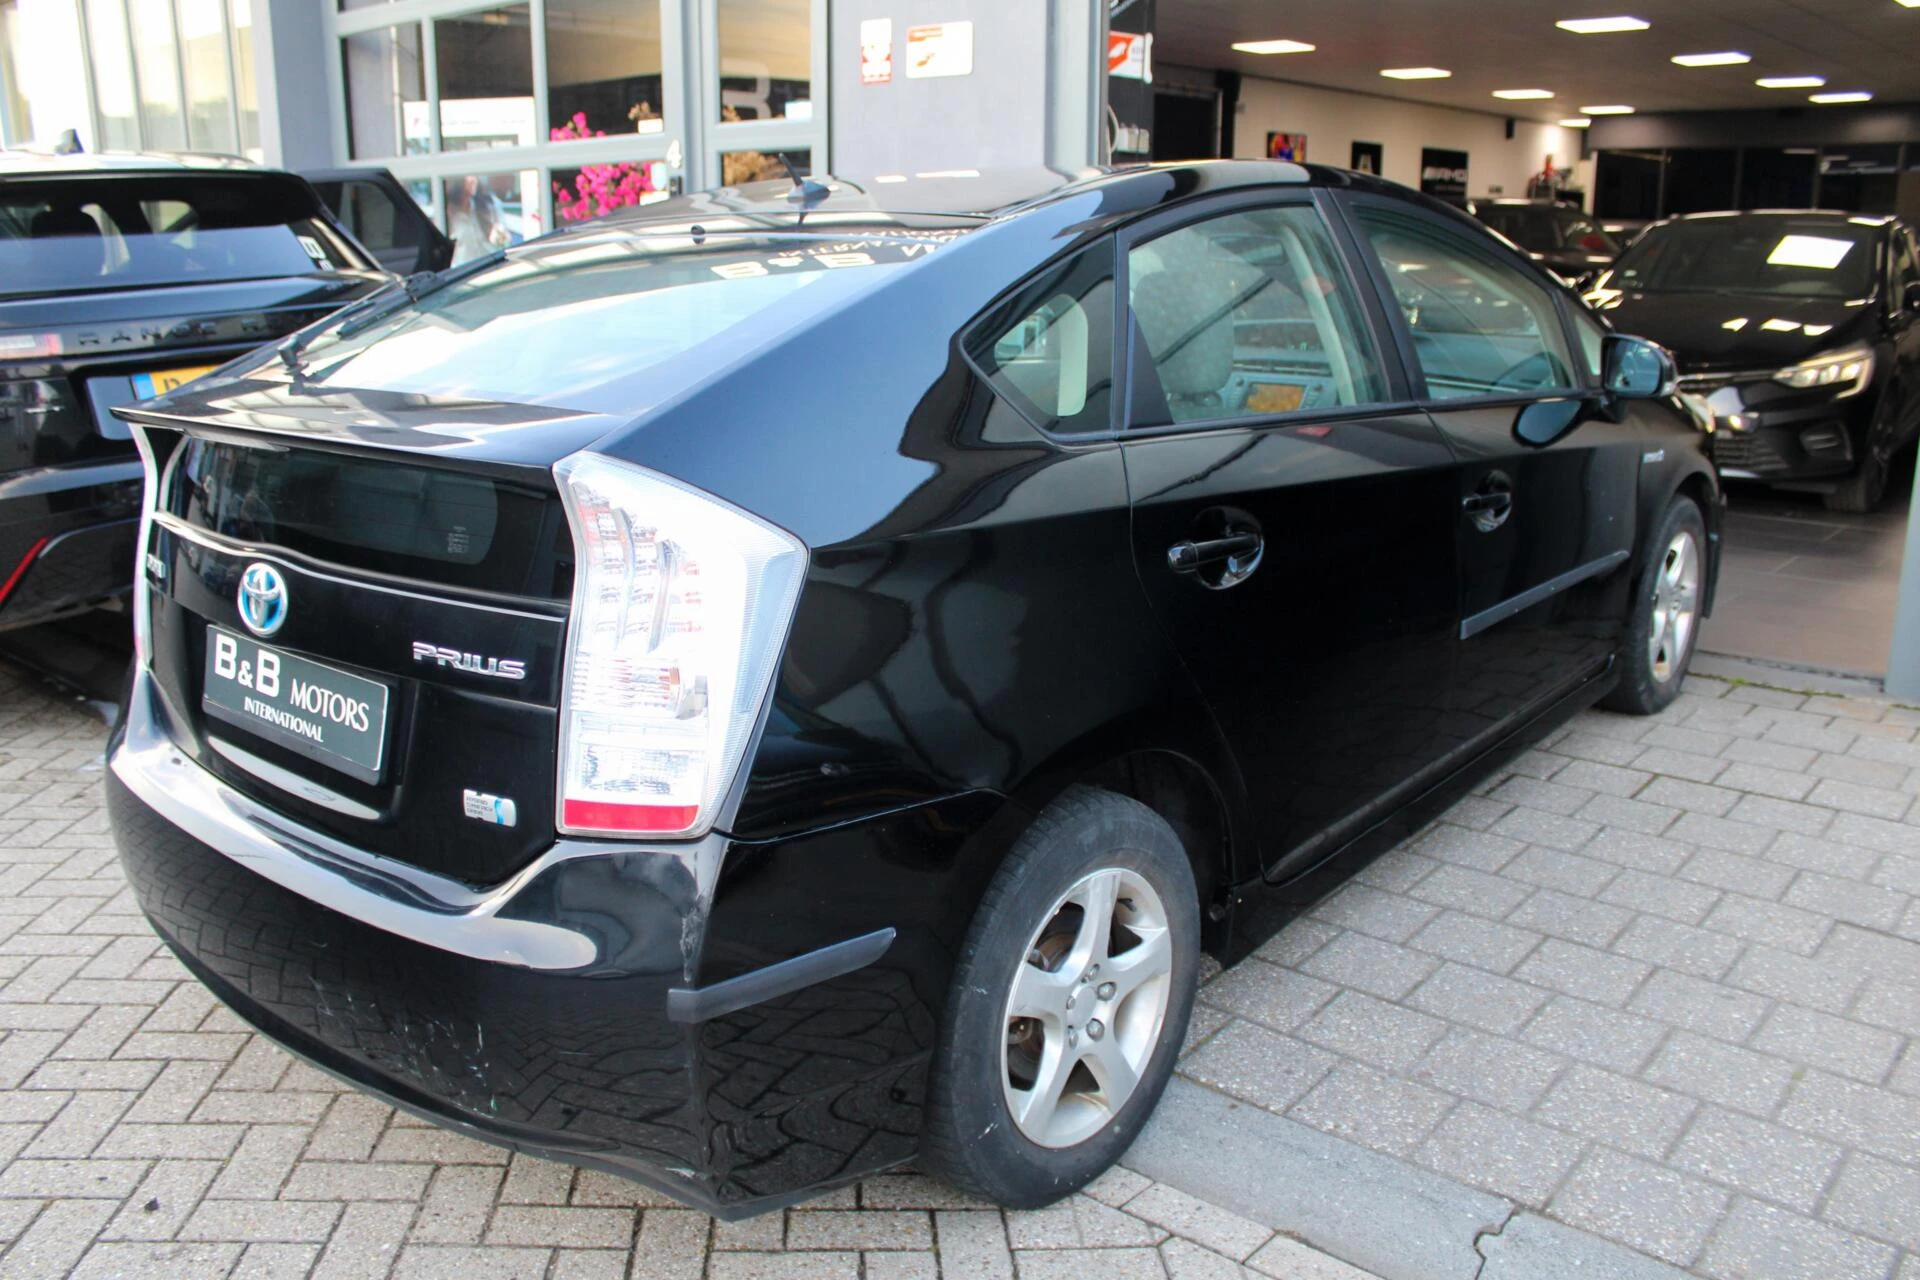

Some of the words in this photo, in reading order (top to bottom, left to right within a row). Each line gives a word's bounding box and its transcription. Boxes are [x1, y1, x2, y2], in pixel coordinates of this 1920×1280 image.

[412, 641, 526, 680] PRIUS
[244, 696, 324, 742] INTERNATIONAL
[290, 678, 369, 732] MOTORS
